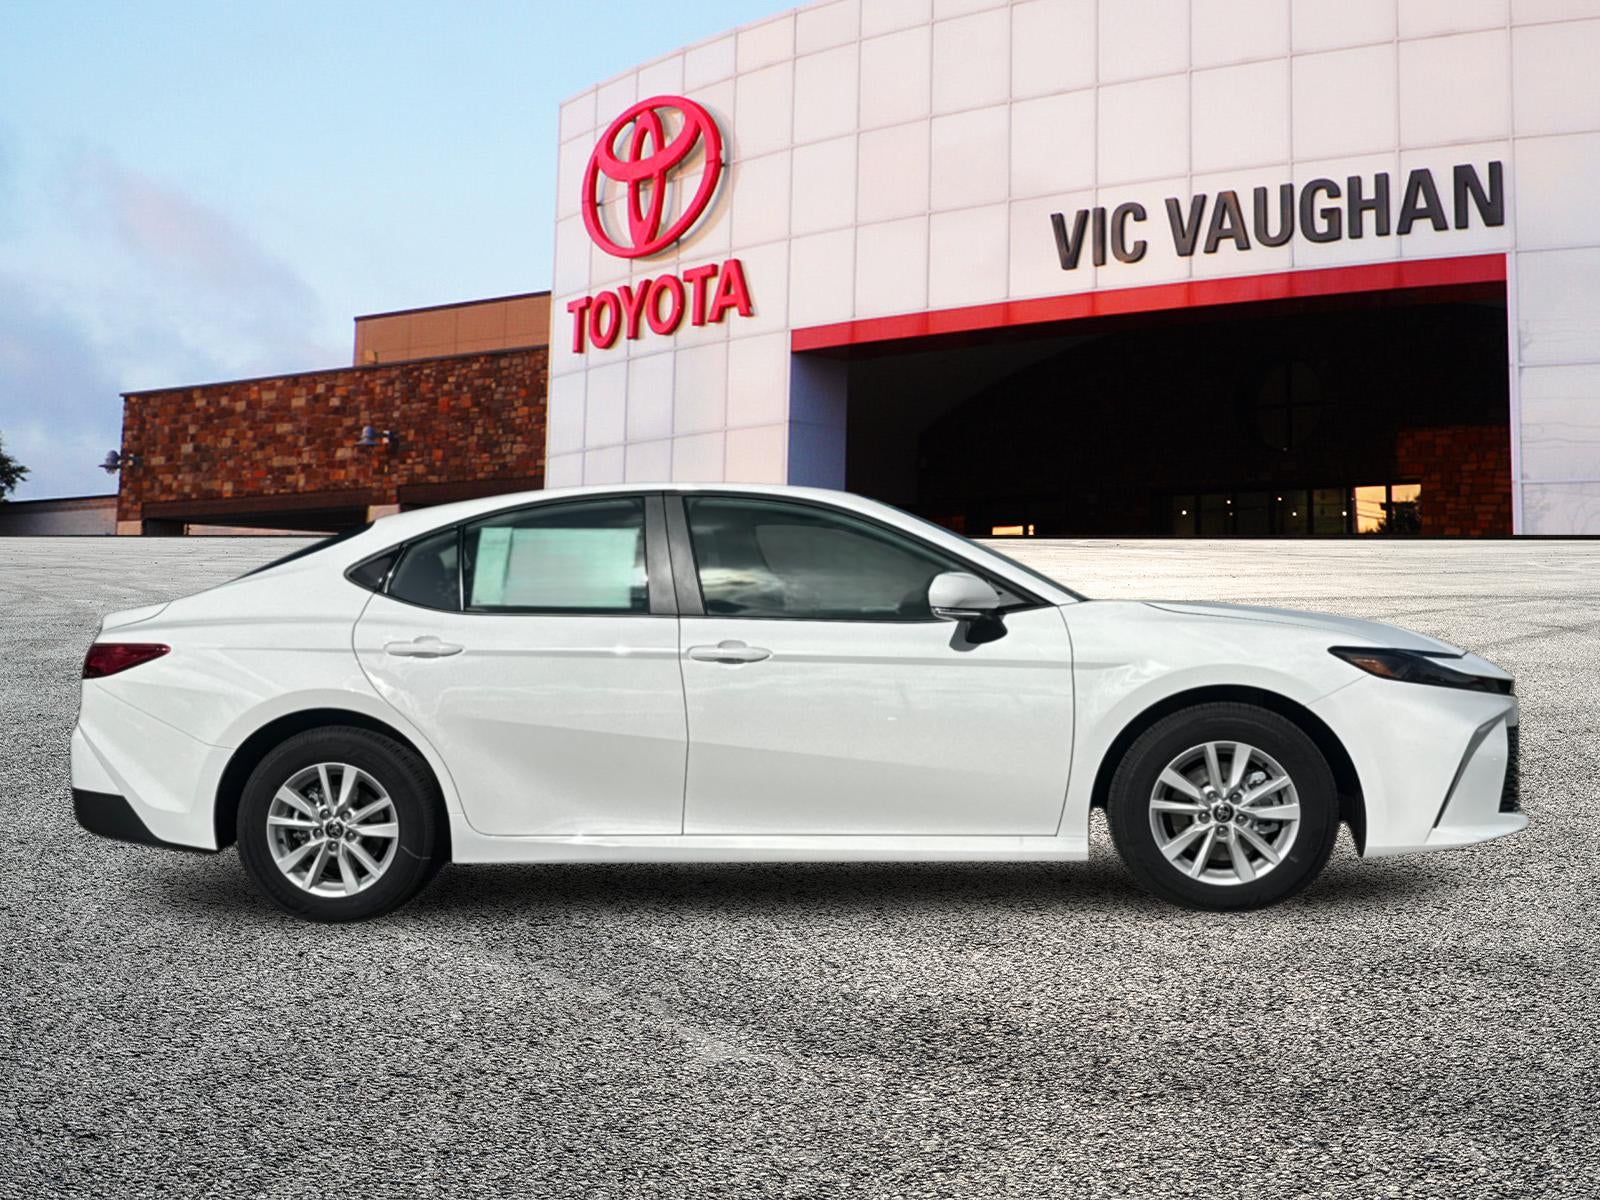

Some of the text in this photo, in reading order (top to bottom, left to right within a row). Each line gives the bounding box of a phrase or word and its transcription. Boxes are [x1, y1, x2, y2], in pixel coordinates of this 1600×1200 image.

[1050, 161, 1504, 270] VIC VAUGHAN
[567, 258, 753, 353] TOYOTA
